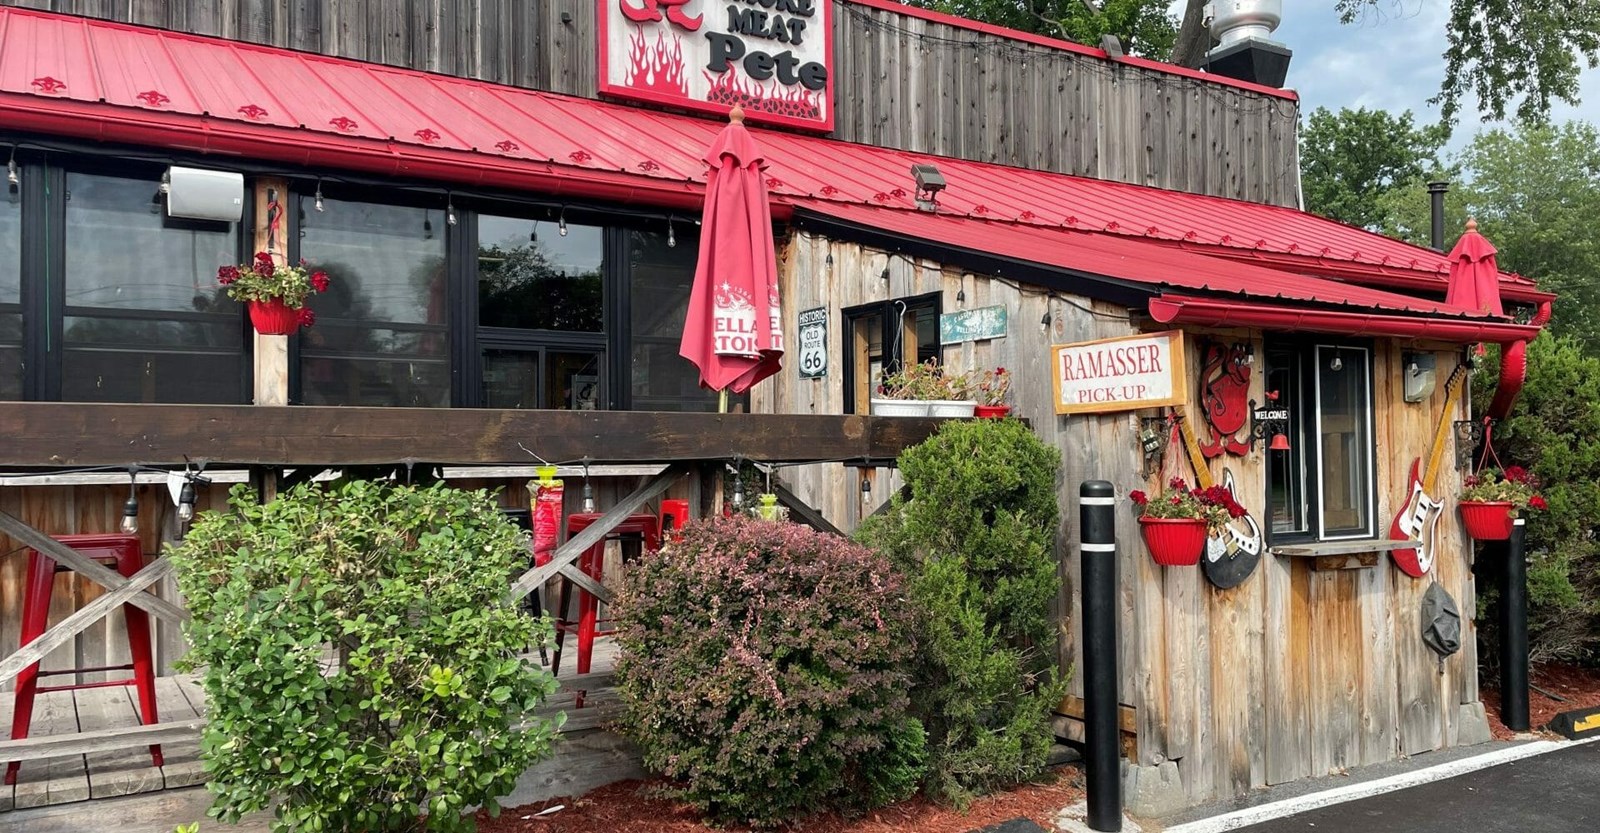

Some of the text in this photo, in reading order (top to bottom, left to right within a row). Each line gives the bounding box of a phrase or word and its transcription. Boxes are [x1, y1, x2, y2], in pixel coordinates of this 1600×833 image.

[727, 4, 806, 45] MEAT
[704, 31, 828, 90] Pete
[800, 309, 826, 323] HISTORIC
[804, 340, 821, 349] ROUTE
[806, 331, 819, 341] OLD
[805, 351, 821, 369] 66
[1062, 344, 1163, 381] RAMASSER
[1078, 384, 1146, 403] PICK-UP
[1254, 410, 1288, 420] WELCOME
